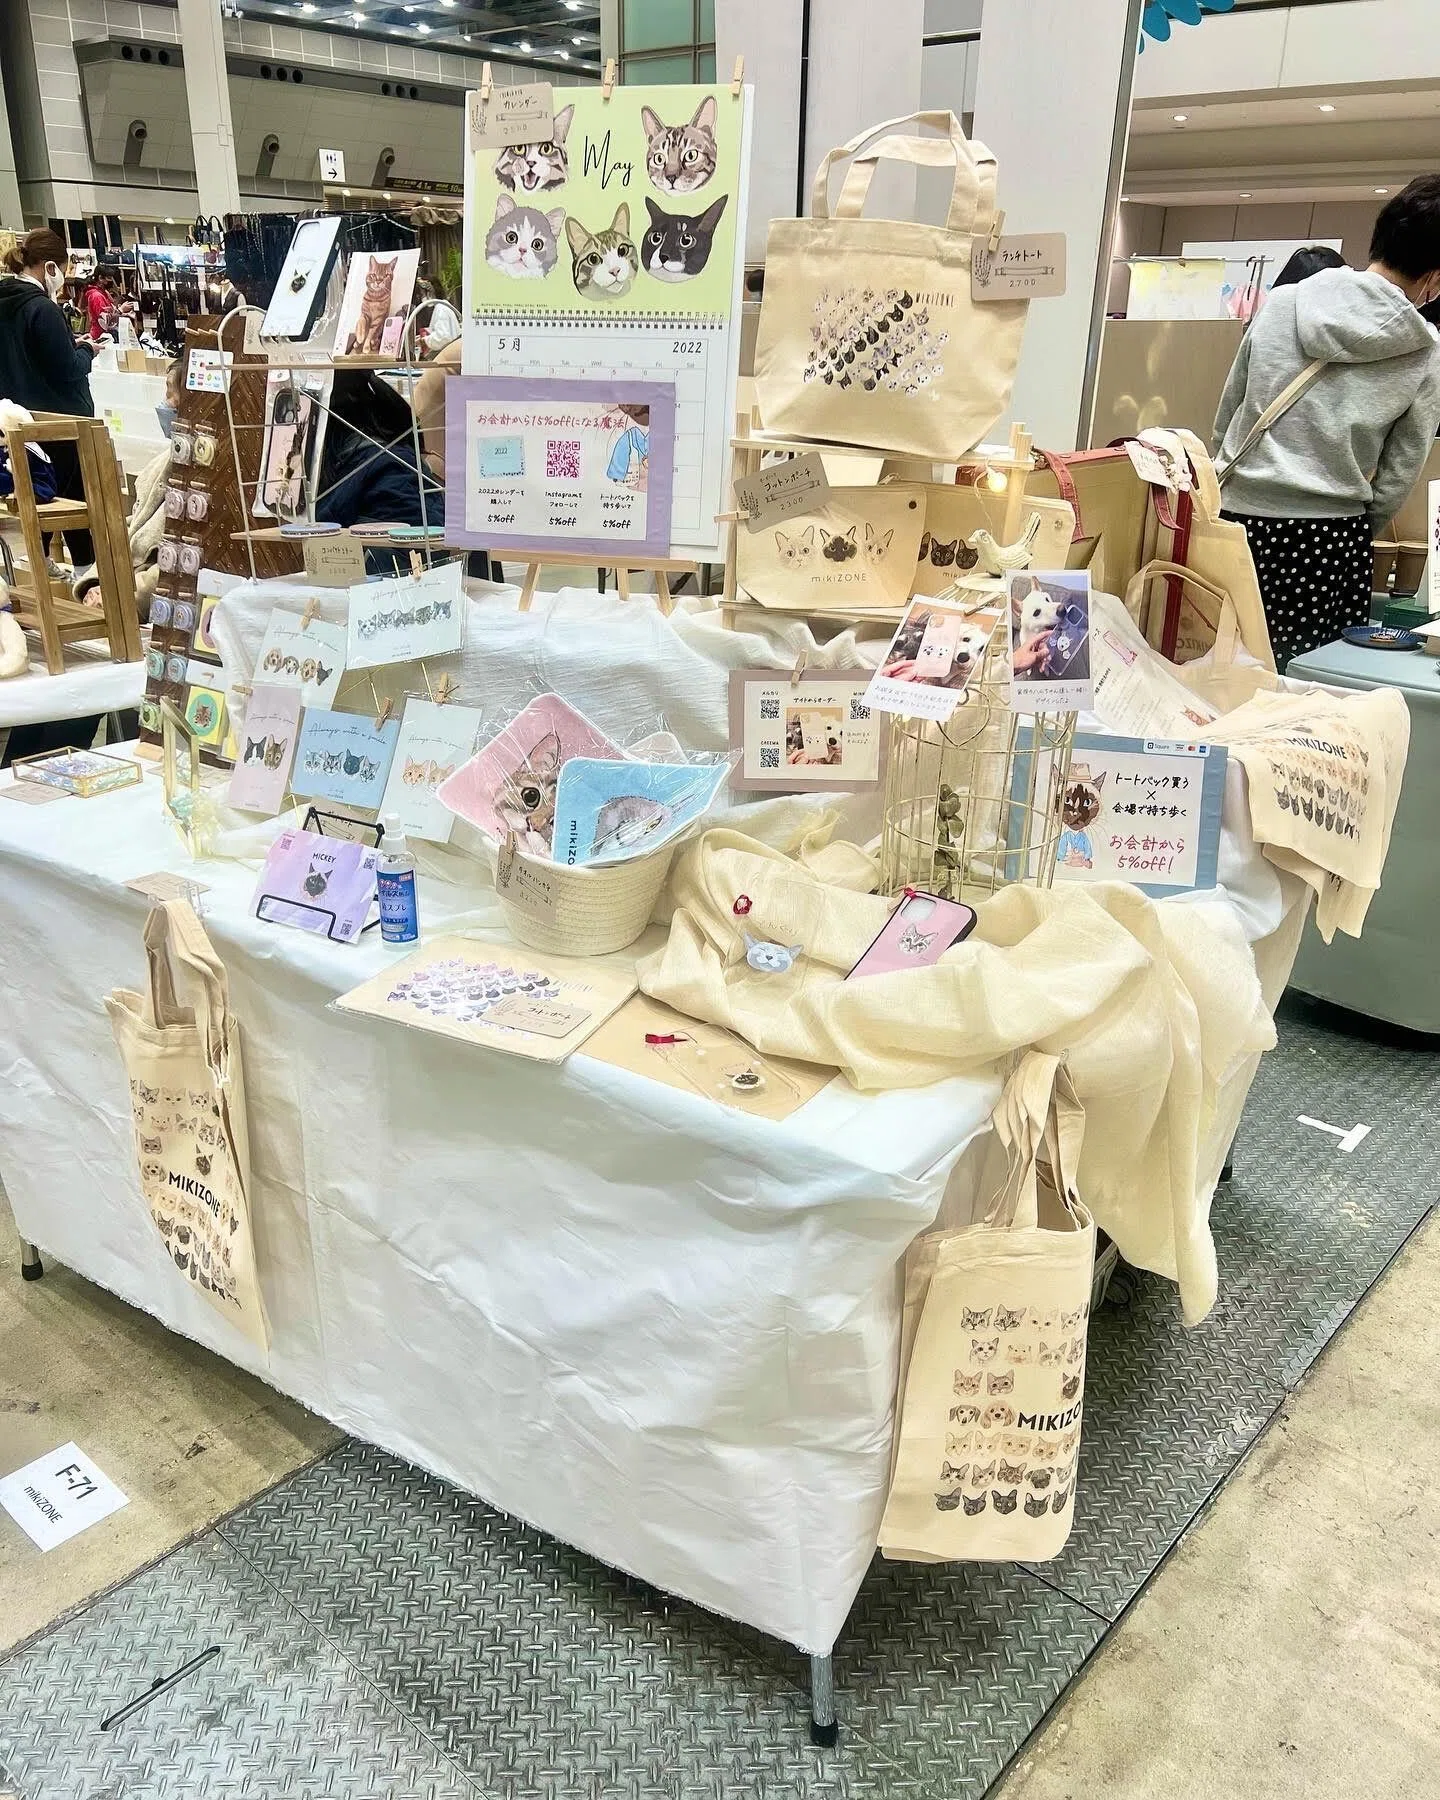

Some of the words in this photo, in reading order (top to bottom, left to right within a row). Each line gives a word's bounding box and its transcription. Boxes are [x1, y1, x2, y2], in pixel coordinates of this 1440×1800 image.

[584, 129, 634, 190] May
[1002, 250, 1042, 262] ランチトート
[673, 341, 702, 354] 2022
[764, 467, 811, 491] コットンポーチ
[487, 514, 515, 524] 5%off
[549, 516, 577, 526] 5%off
[602, 519, 631, 529] 5%off
[812, 572, 867, 583] mikiZONE
[1287, 737, 1348, 759] MIKIZONE
[1112, 802, 1187, 818] 会場で持ち歩く
[1110, 834, 1185, 853] お会計から
[313, 853, 336, 863] MICKEY
[1117, 856, 1174, 874] 5%off!
[169, 1171, 221, 1218] MIKIZONE
[1017, 1401, 1081, 1431] MIKIZO
[55, 1463, 98, 1500] F-71
[24, 1486, 63, 1524] mikiZONE
